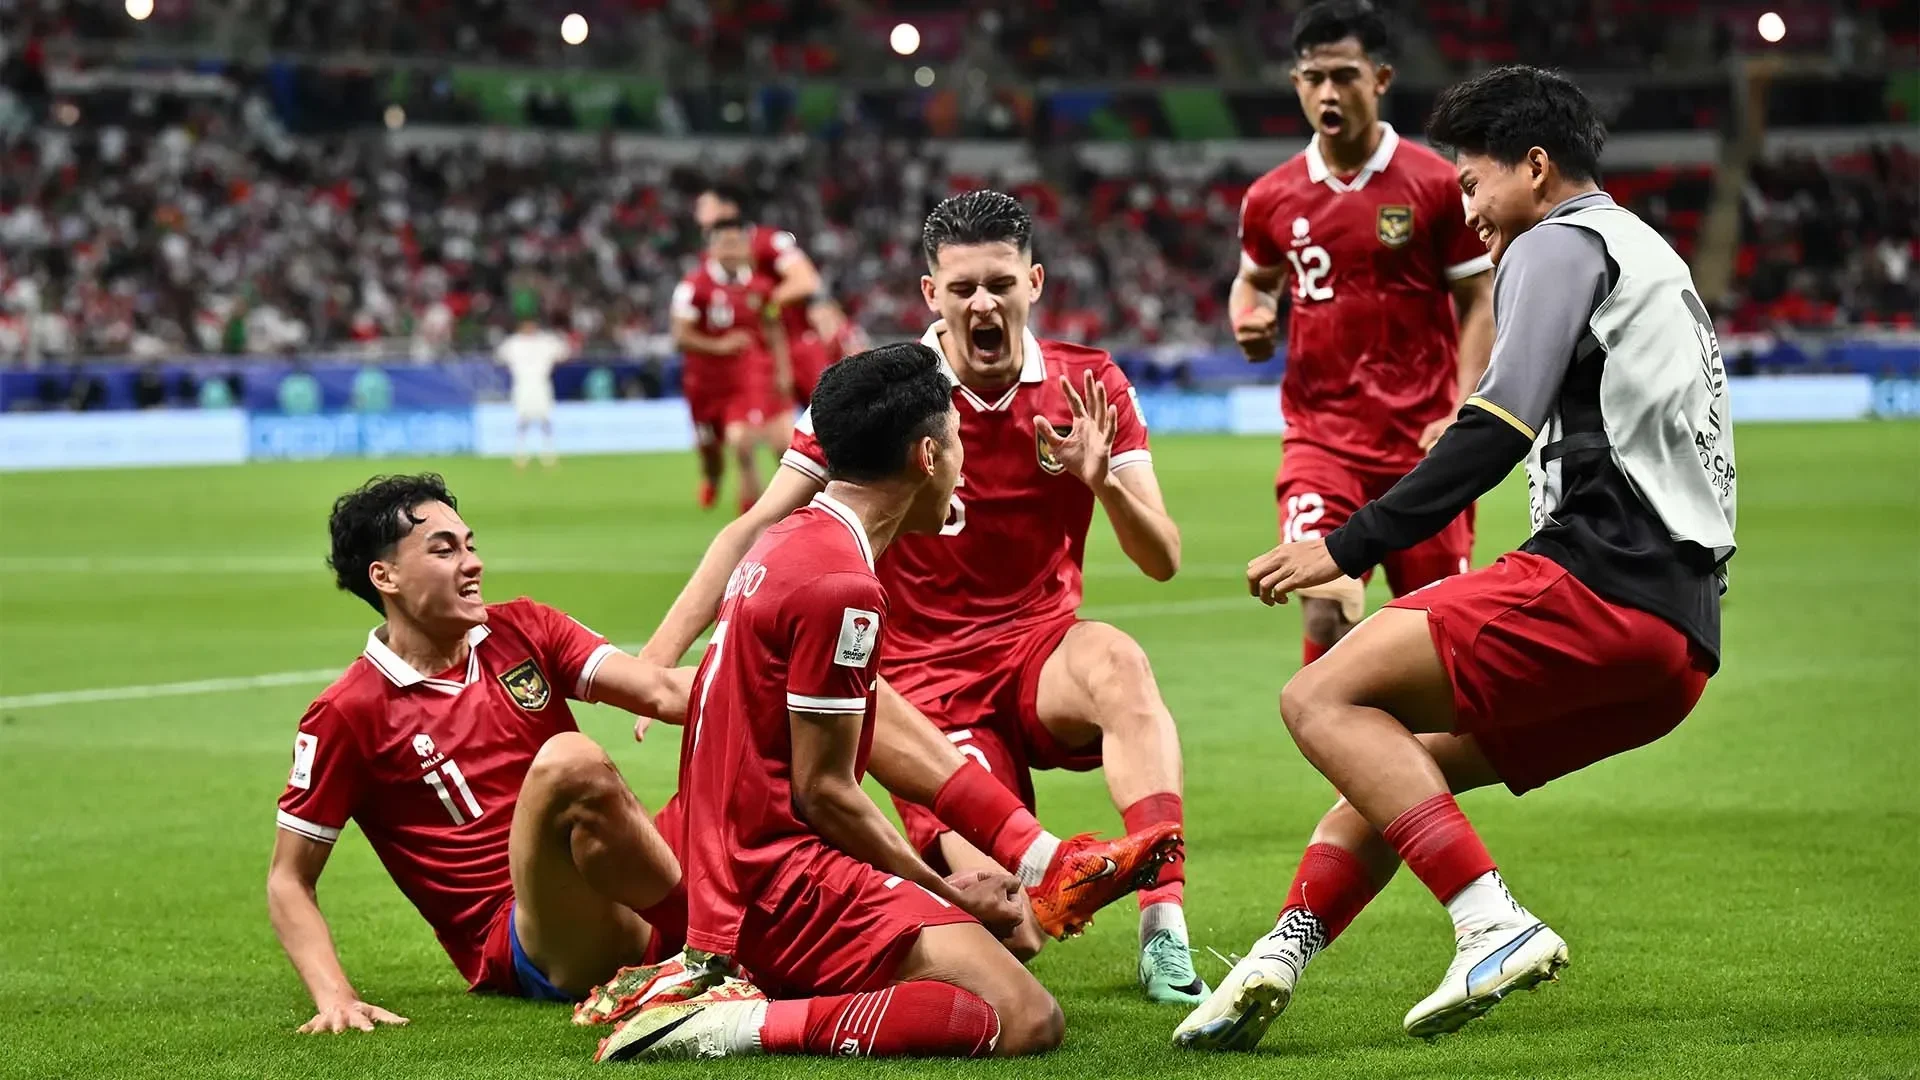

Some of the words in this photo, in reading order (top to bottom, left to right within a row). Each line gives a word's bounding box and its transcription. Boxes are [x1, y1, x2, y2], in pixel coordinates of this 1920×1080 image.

[1286, 245, 1334, 301] 12
[1283, 492, 1325, 545] 12
[420, 752, 445, 770] MILLS
[422, 759, 485, 826] 11
[1280, 948, 1300, 963] KING
